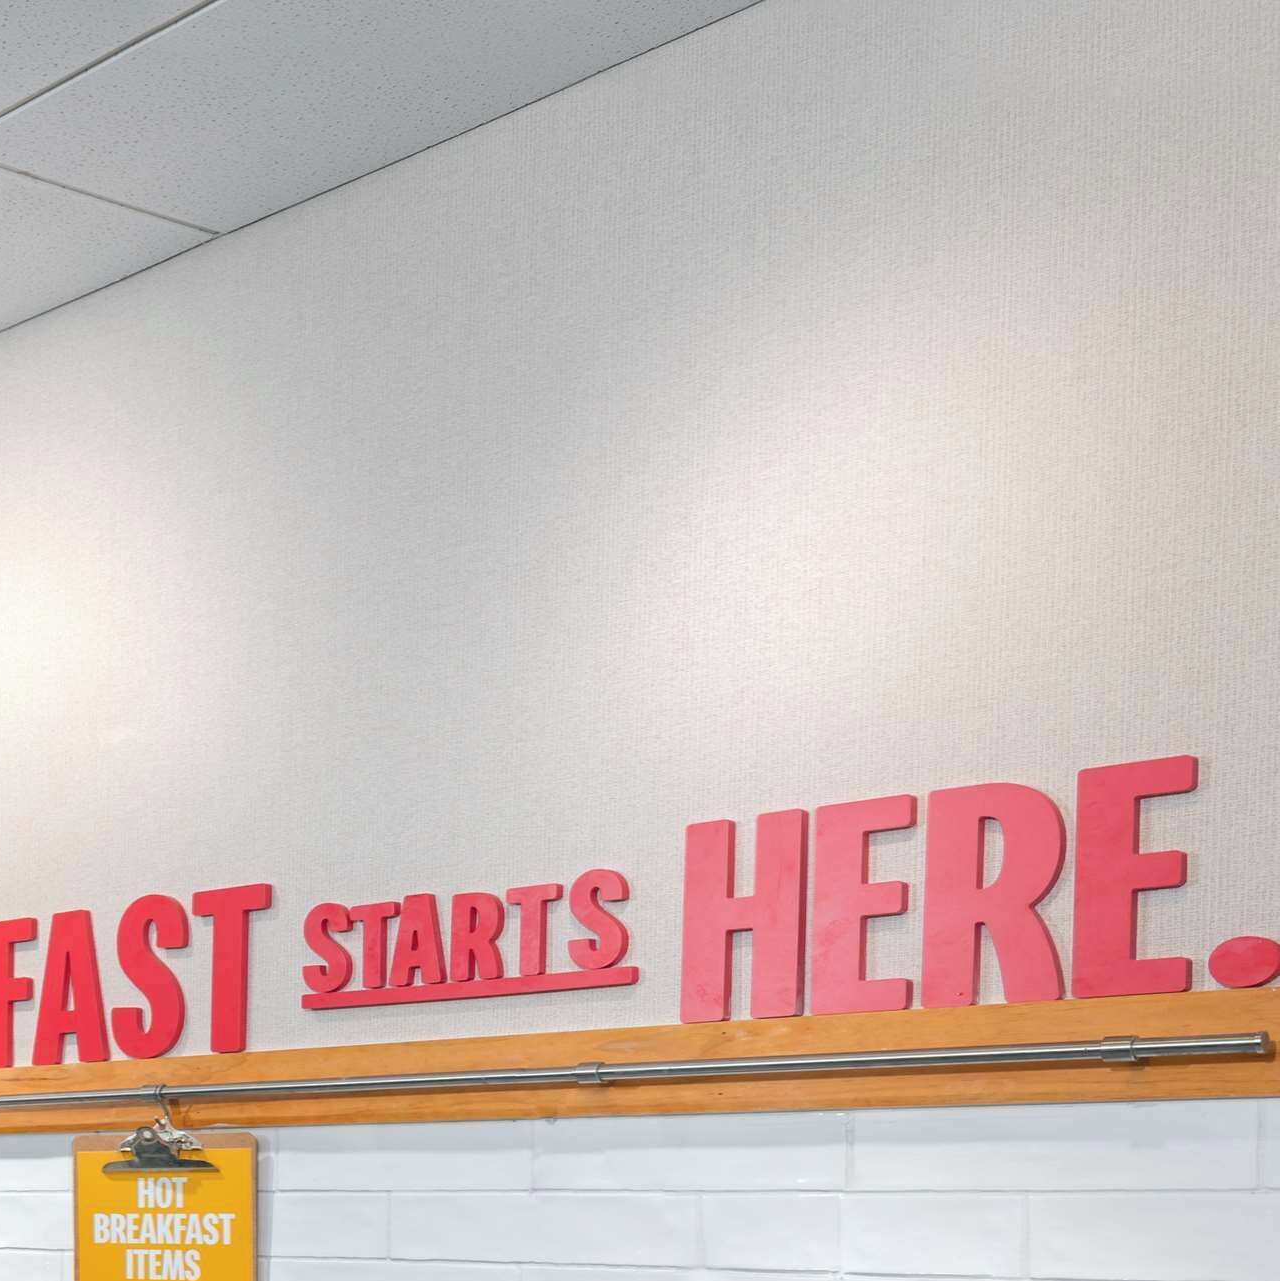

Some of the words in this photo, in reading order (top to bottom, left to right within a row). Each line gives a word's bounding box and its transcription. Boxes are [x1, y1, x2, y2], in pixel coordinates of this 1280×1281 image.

[302, 868, 631, 995] STARTS
[679, 754, 1280, 1024] HERE.
[136, 1176, 188, 1209] HOT
[93, 1213, 236, 1246] BREAKFAST
[125, 1249, 201, 1281] ITEMS
